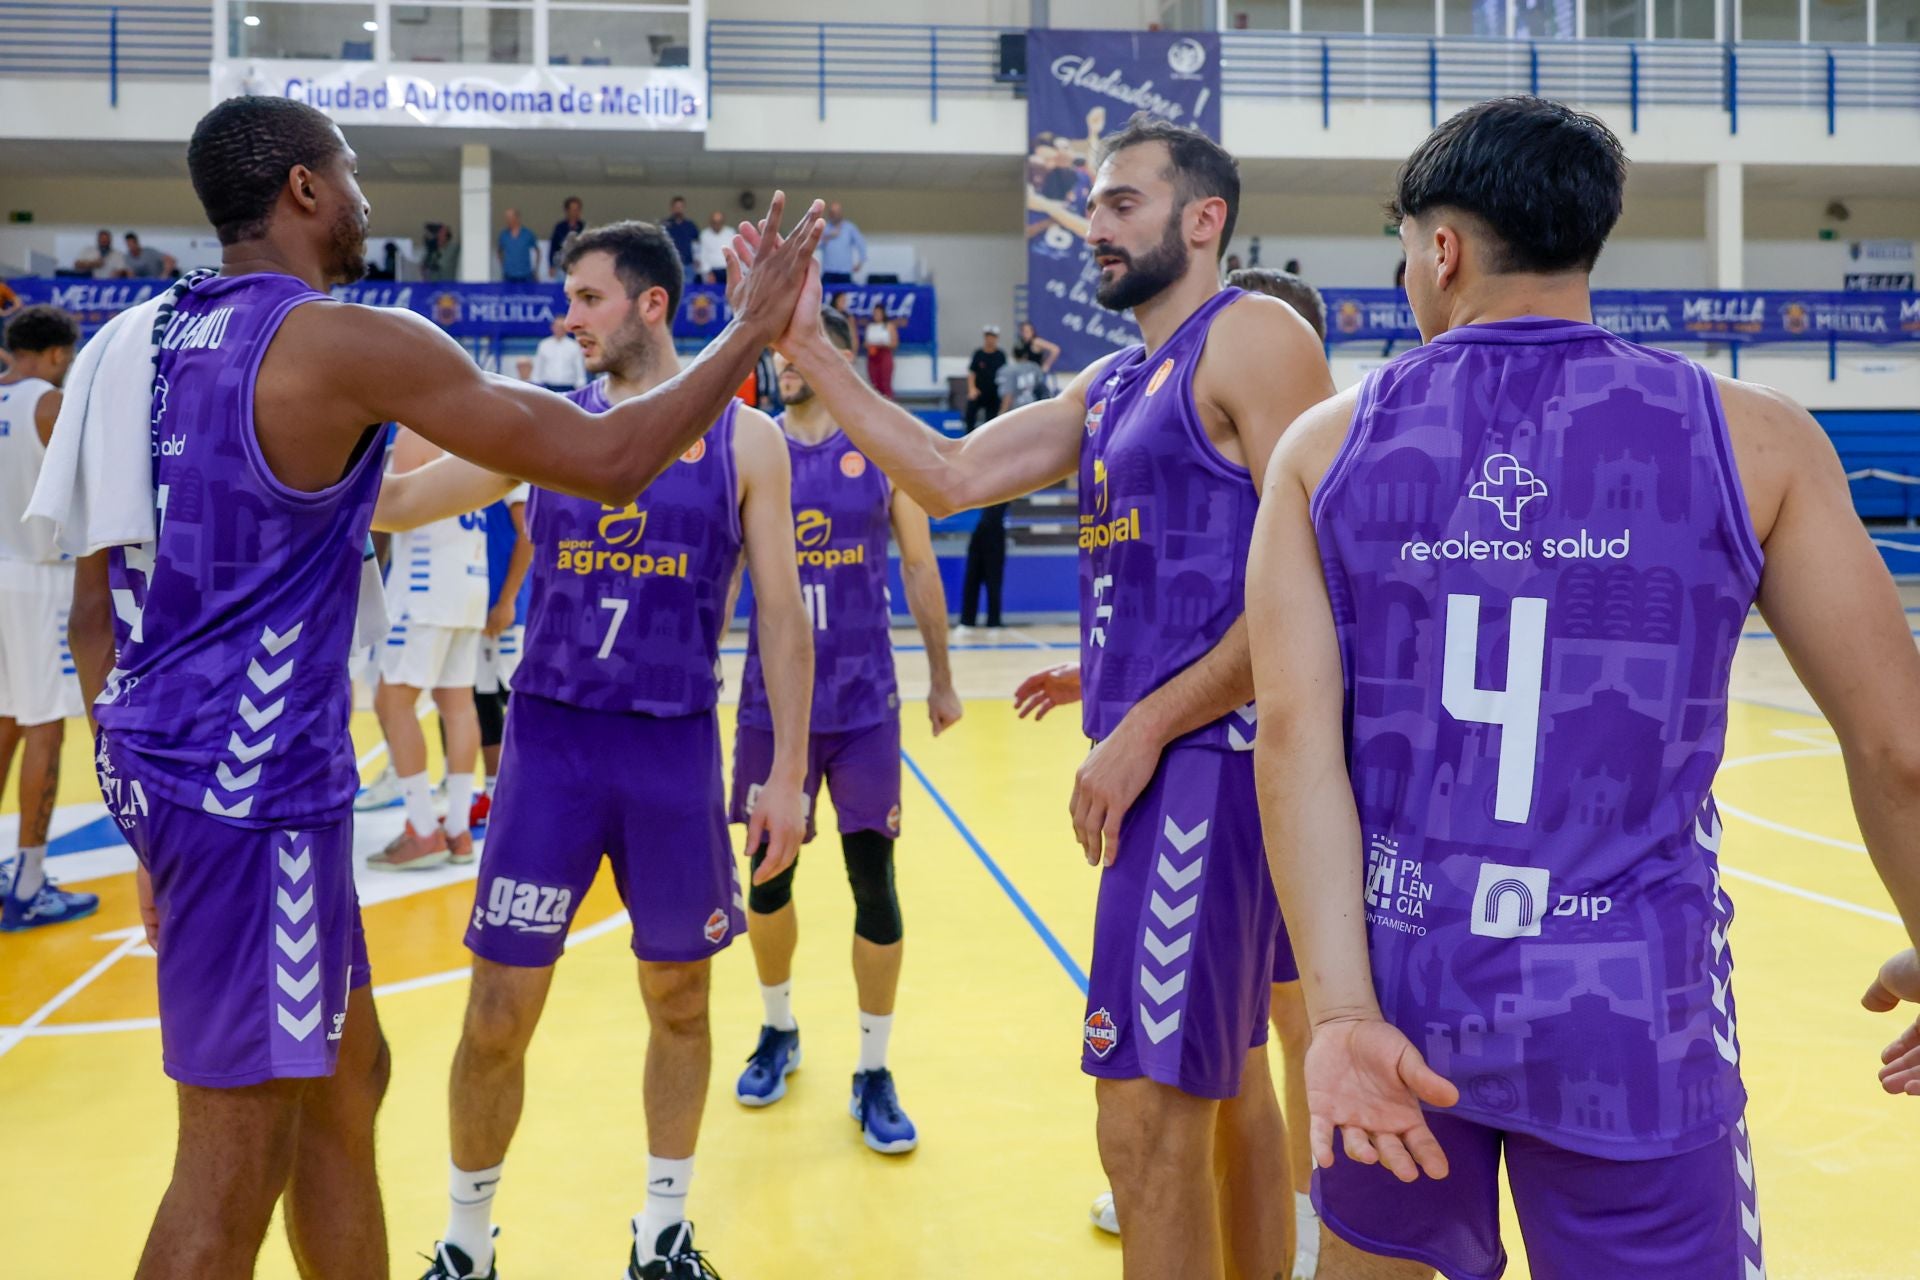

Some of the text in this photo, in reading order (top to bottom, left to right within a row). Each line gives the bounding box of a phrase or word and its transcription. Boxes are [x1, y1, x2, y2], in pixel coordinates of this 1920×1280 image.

[285, 79, 697, 116] Ciudad Autónoma de Melilla
[469, 302, 553, 322] MELILLA
[1682, 297, 1766, 322] MELILLA
[1596, 314, 1671, 333] MELILLA
[1816, 313, 1887, 332] MELILLA
[797, 544, 864, 569] ropal
[1400, 528, 1630, 561] recoletas salud
[557, 550, 688, 578] agropal
[803, 583, 828, 630] 11
[597, 597, 629, 660] 7
[1441, 593, 1548, 824] 4
[1400, 859, 1423, 879] PA
[486, 876, 572, 927] gaza
[1399, 877, 1433, 901] LEN
[1396, 895, 1424, 919] CIA
